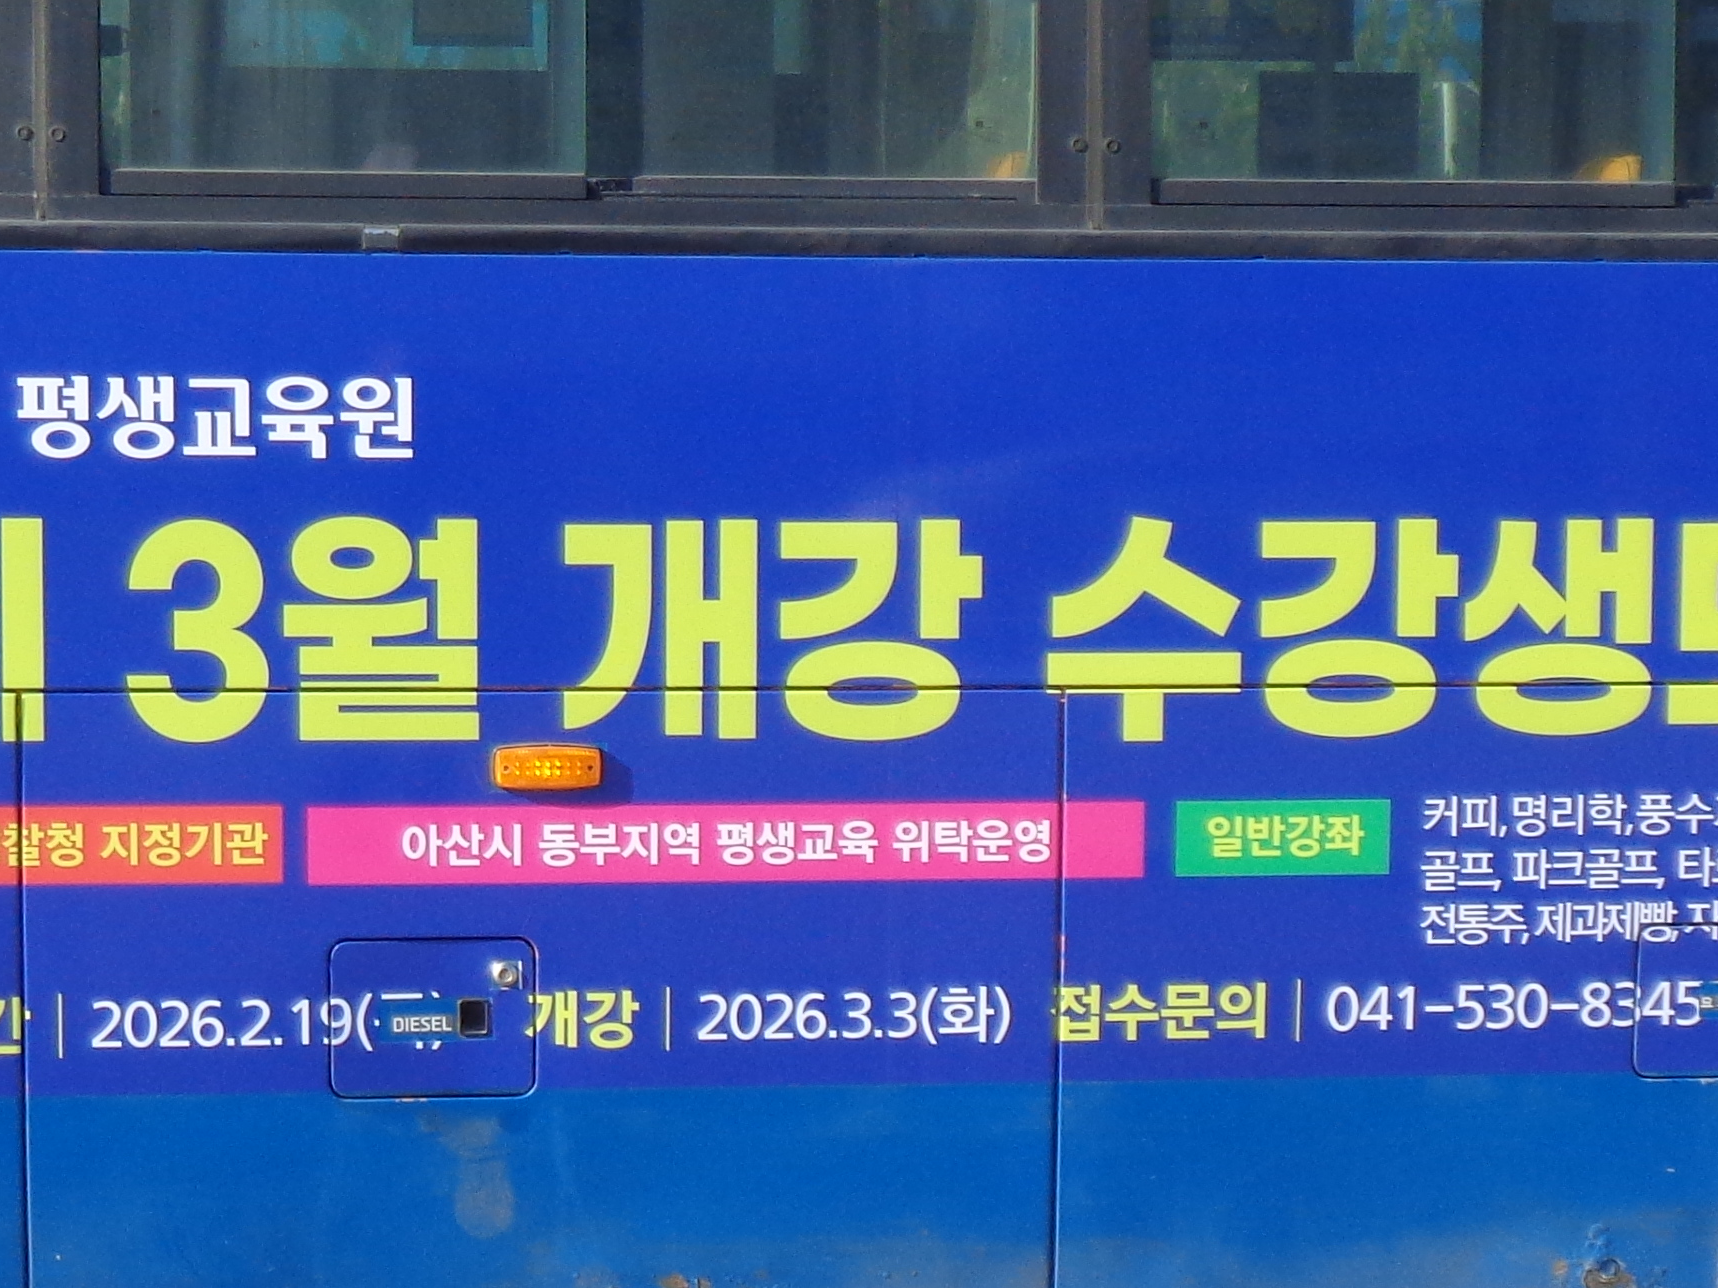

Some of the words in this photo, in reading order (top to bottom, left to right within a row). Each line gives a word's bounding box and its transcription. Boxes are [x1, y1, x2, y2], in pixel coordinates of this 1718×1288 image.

[16, 375, 414, 459] 평생교육원
[126, 516, 480, 743] 3월
[563, 518, 983, 743] 개강
[99, 821, 269, 867] 지정기관
[401, 823, 522, 867] 아산시
[538, 822, 700, 867] 동부지역
[716, 820, 879, 866] 평생교육
[892, 819, 1051, 863] 위탁운영
[1206, 814, 1365, 858] 일반강좌
[1420, 850, 1502, 892] 골프,
[1512, 848, 1665, 890] 파크골프,
[1420, 903, 1530, 946] 전통주,
[1534, 900, 1679, 943] 제과제빵,
[392, 1015, 453, 1033] DIESEL
[526, 990, 638, 1049] 개강
[697, 985, 1011, 1045] 2026.3.3(화)
[1050, 983, 1267, 1042] 접수문의
[1326, 980, 1704, 1032] 041-530-8345
